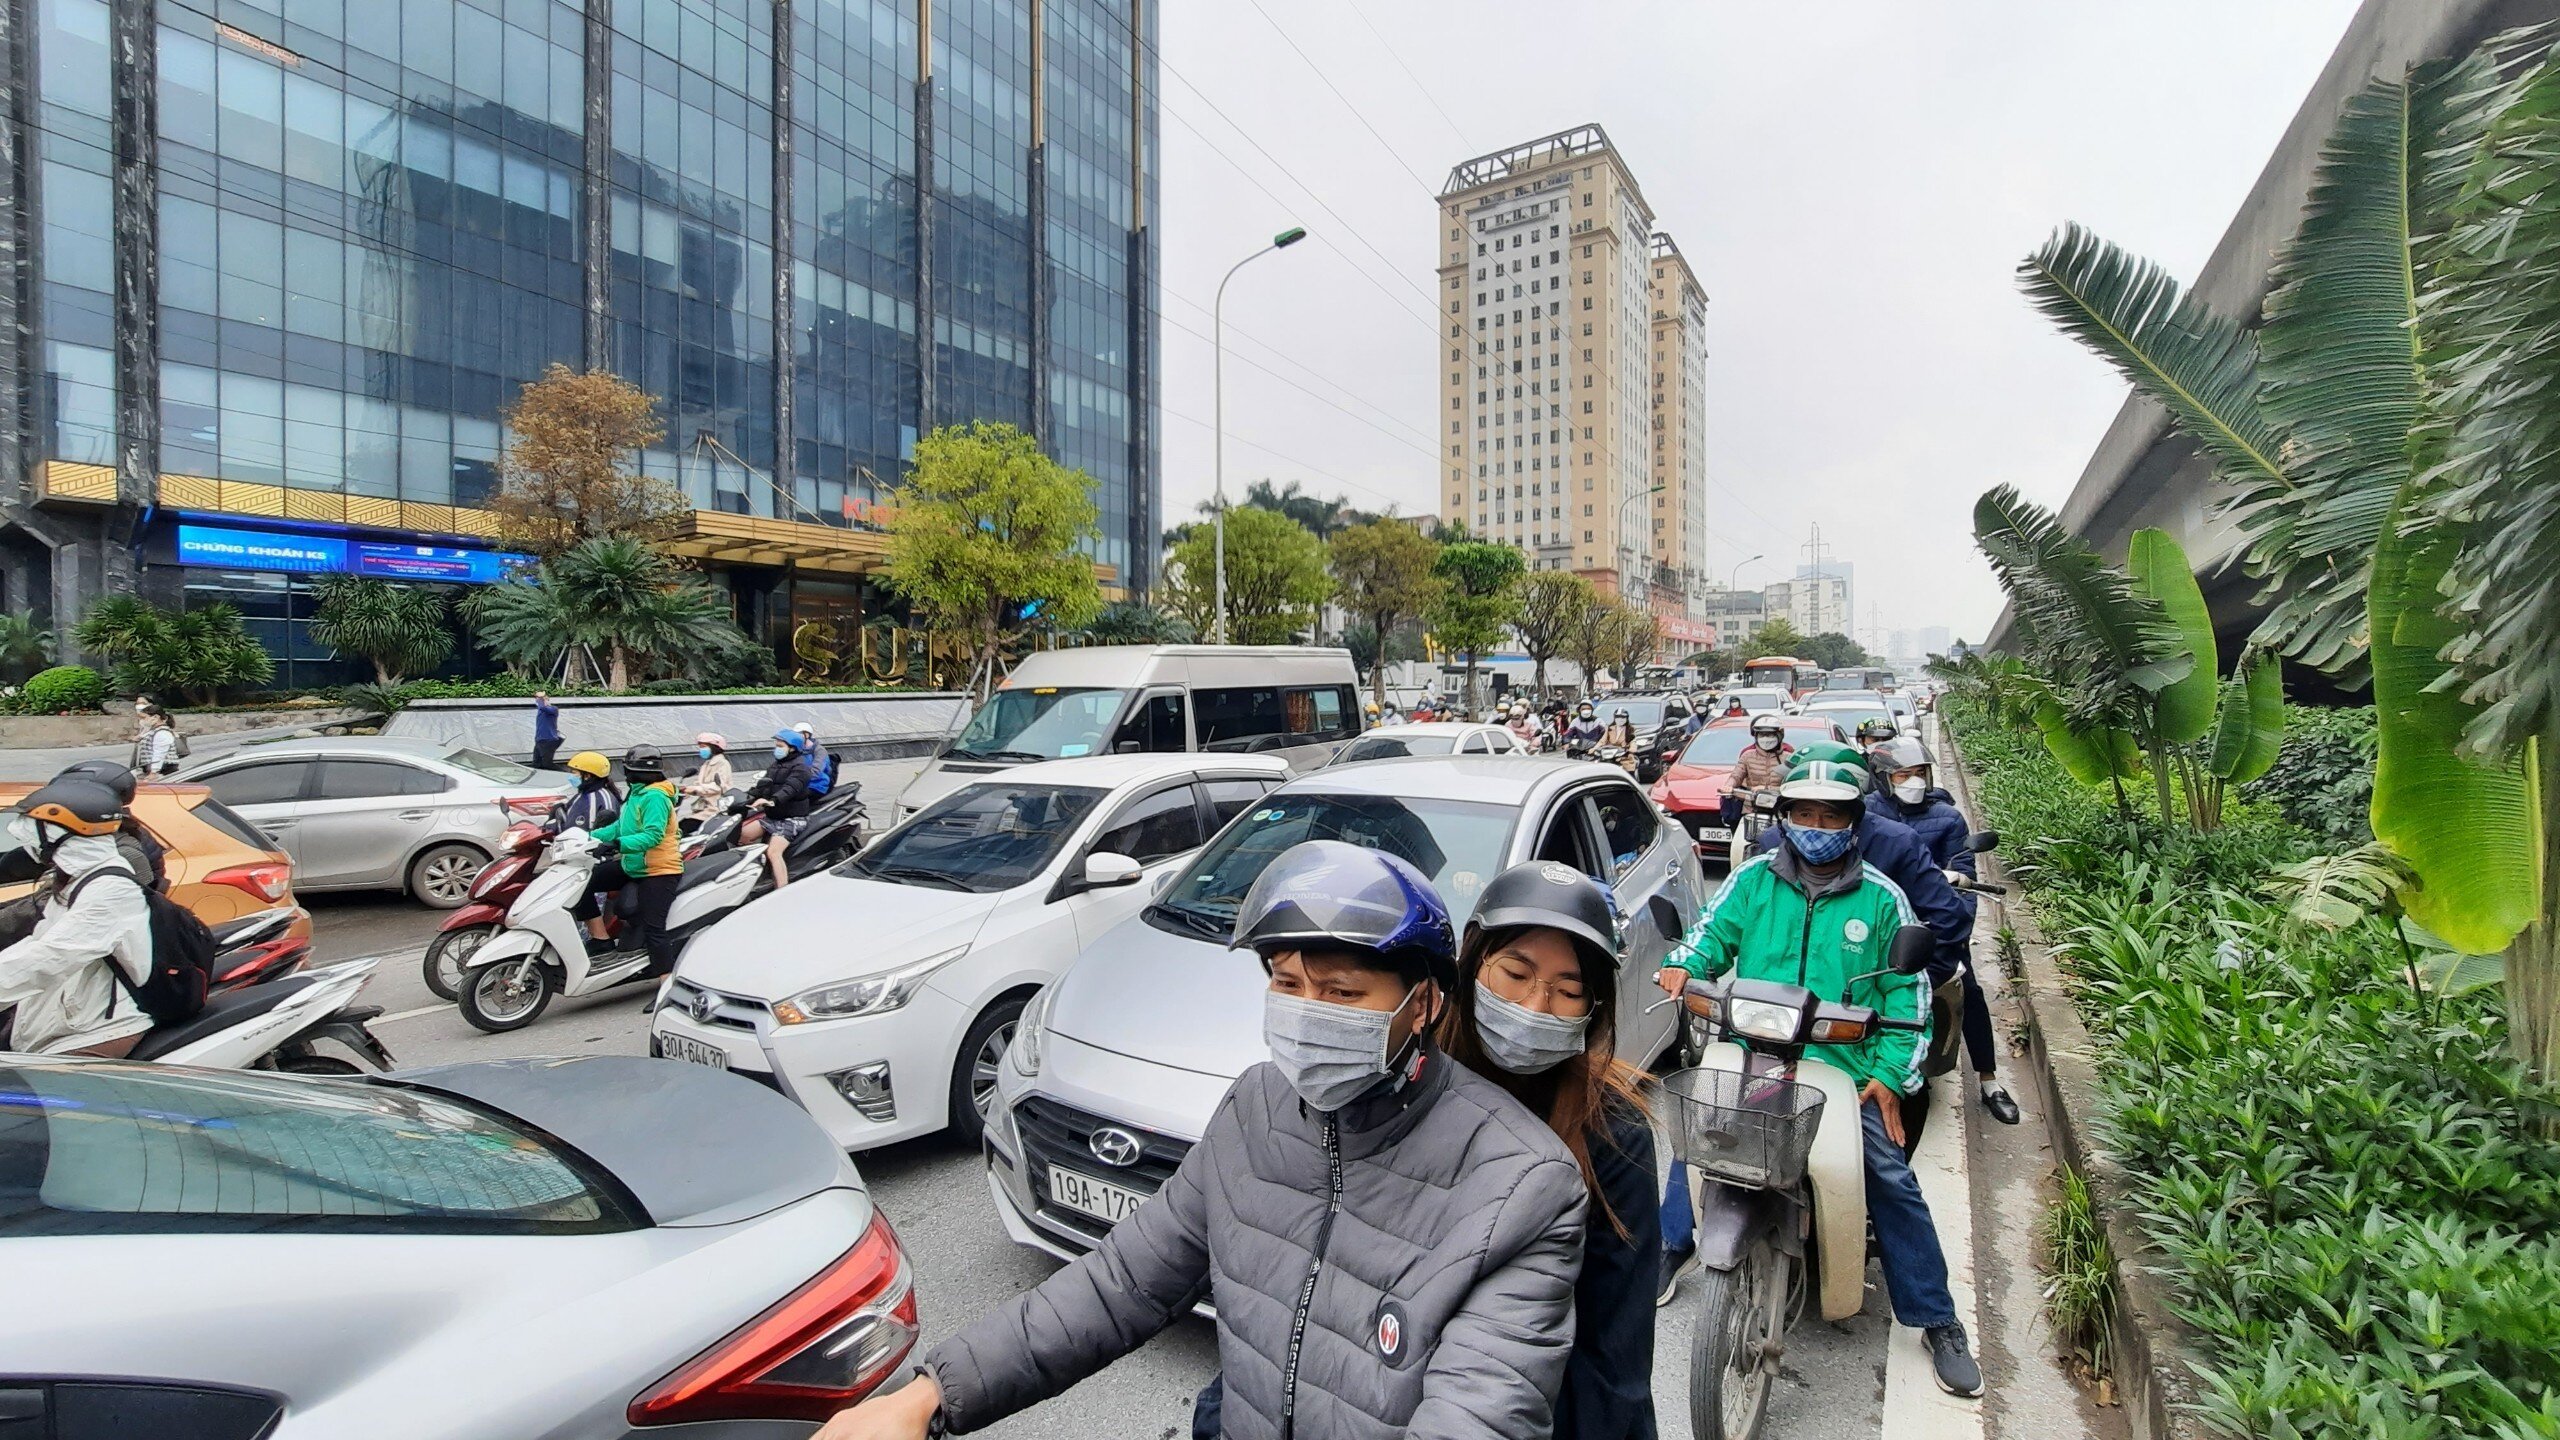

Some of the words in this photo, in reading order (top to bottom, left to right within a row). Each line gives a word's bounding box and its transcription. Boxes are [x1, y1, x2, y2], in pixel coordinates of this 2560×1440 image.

[248, 545, 303, 559] KHOÁN
[306, 551, 327, 560] KS
[1842, 941, 1864, 955] Grab
